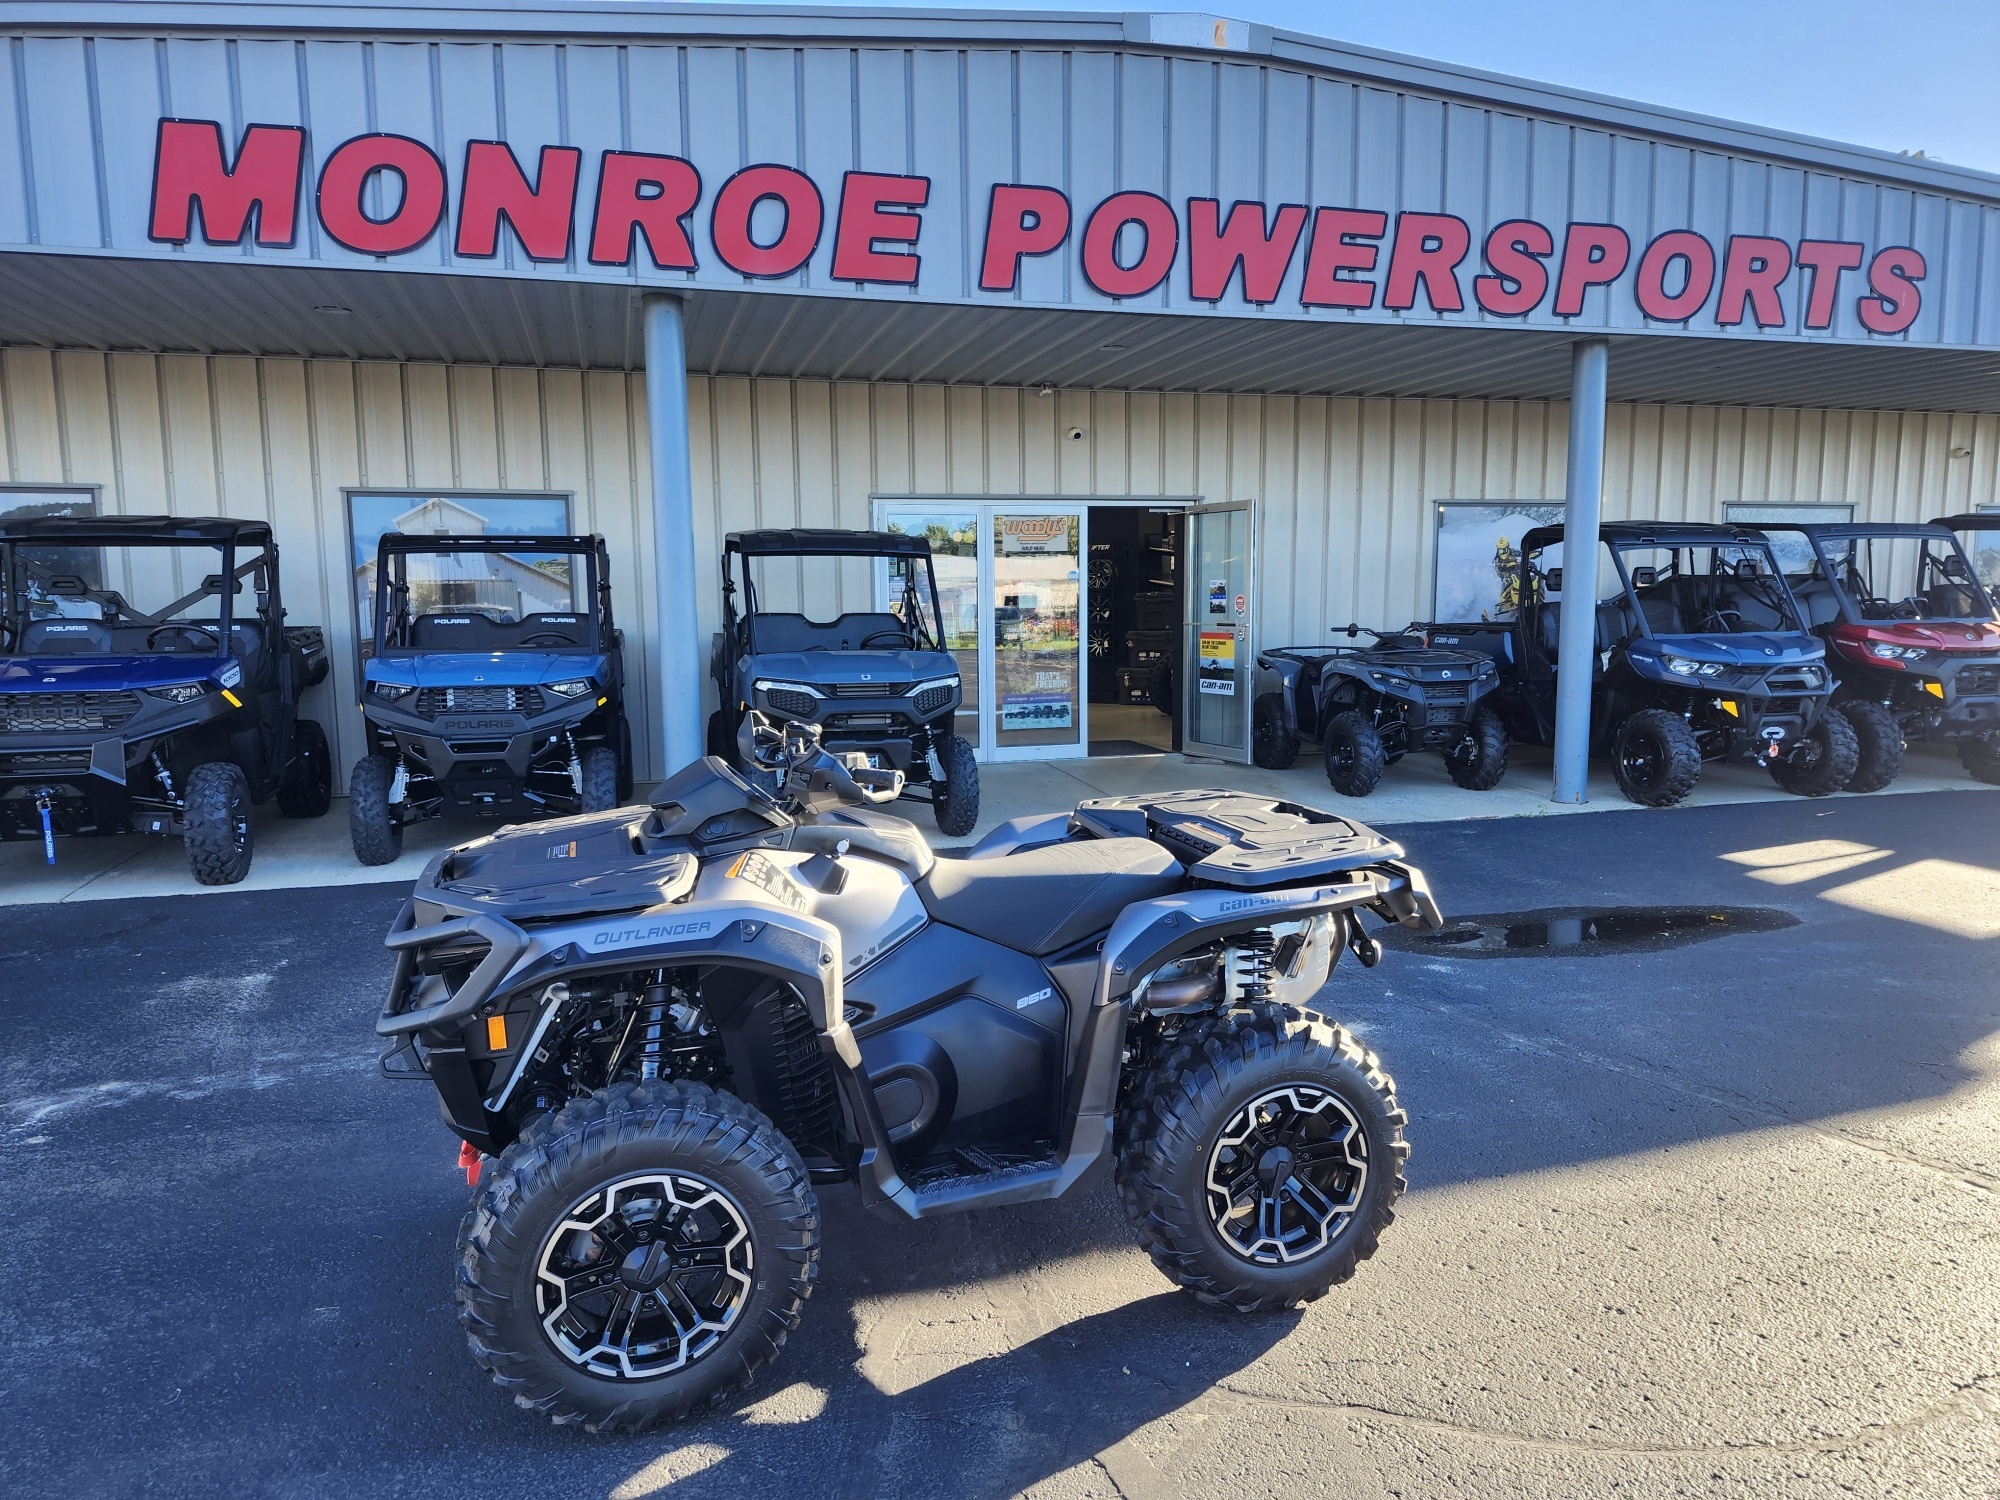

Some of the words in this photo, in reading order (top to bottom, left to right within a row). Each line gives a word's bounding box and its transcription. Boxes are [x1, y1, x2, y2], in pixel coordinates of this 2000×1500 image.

[148, 117, 931, 287] MONROE
[979, 183, 1927, 335] POWERSPORTS
[1434, 635, 1460, 645] can-am
[1035, 671, 1061, 680] THAT'S
[1035, 680, 1068, 688] FREEDOM
[1201, 680, 1233, 691] can-am
[0, 705, 102, 720] POLARIS
[445, 719, 514, 730] POLARIS
[593, 921, 712, 946] OUTLANDER
[1016, 987, 1052, 1010] 850
